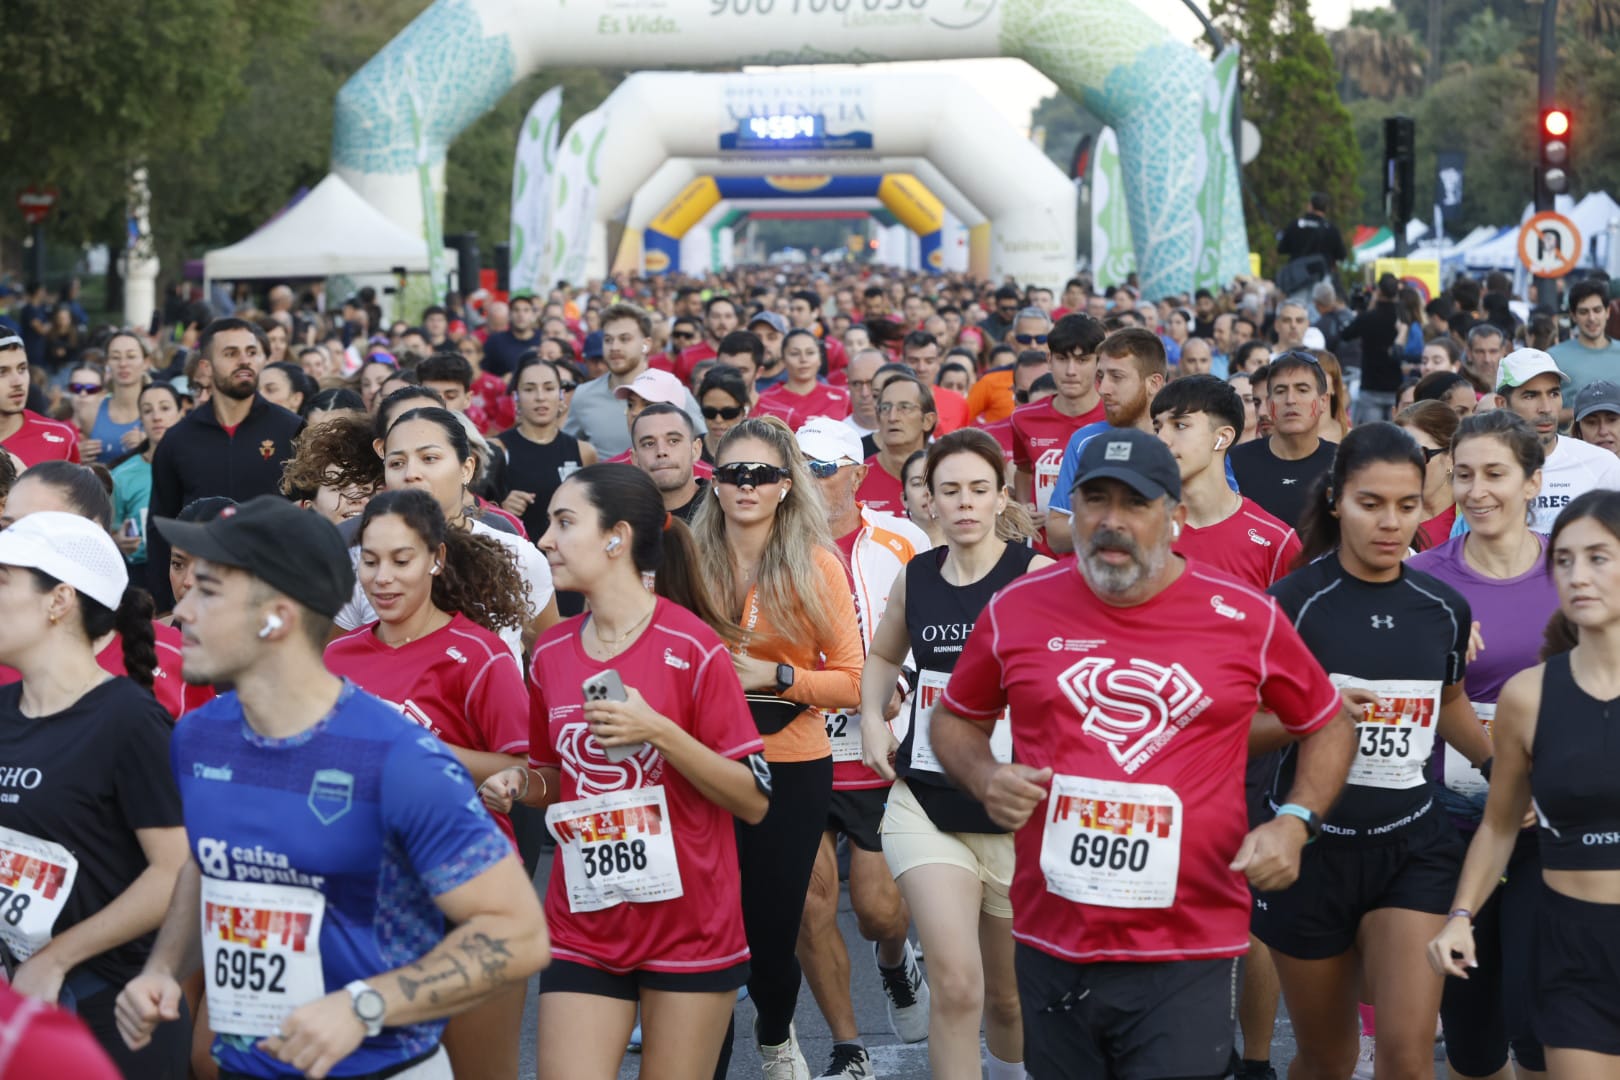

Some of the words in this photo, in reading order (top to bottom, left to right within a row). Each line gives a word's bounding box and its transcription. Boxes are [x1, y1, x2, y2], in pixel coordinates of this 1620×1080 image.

[231, 845, 290, 868] caixa
[581, 838, 648, 879] 3868
[1069, 832, 1150, 873] 6960
[233, 862, 326, 889] popular
[215, 947, 287, 994] 6952
